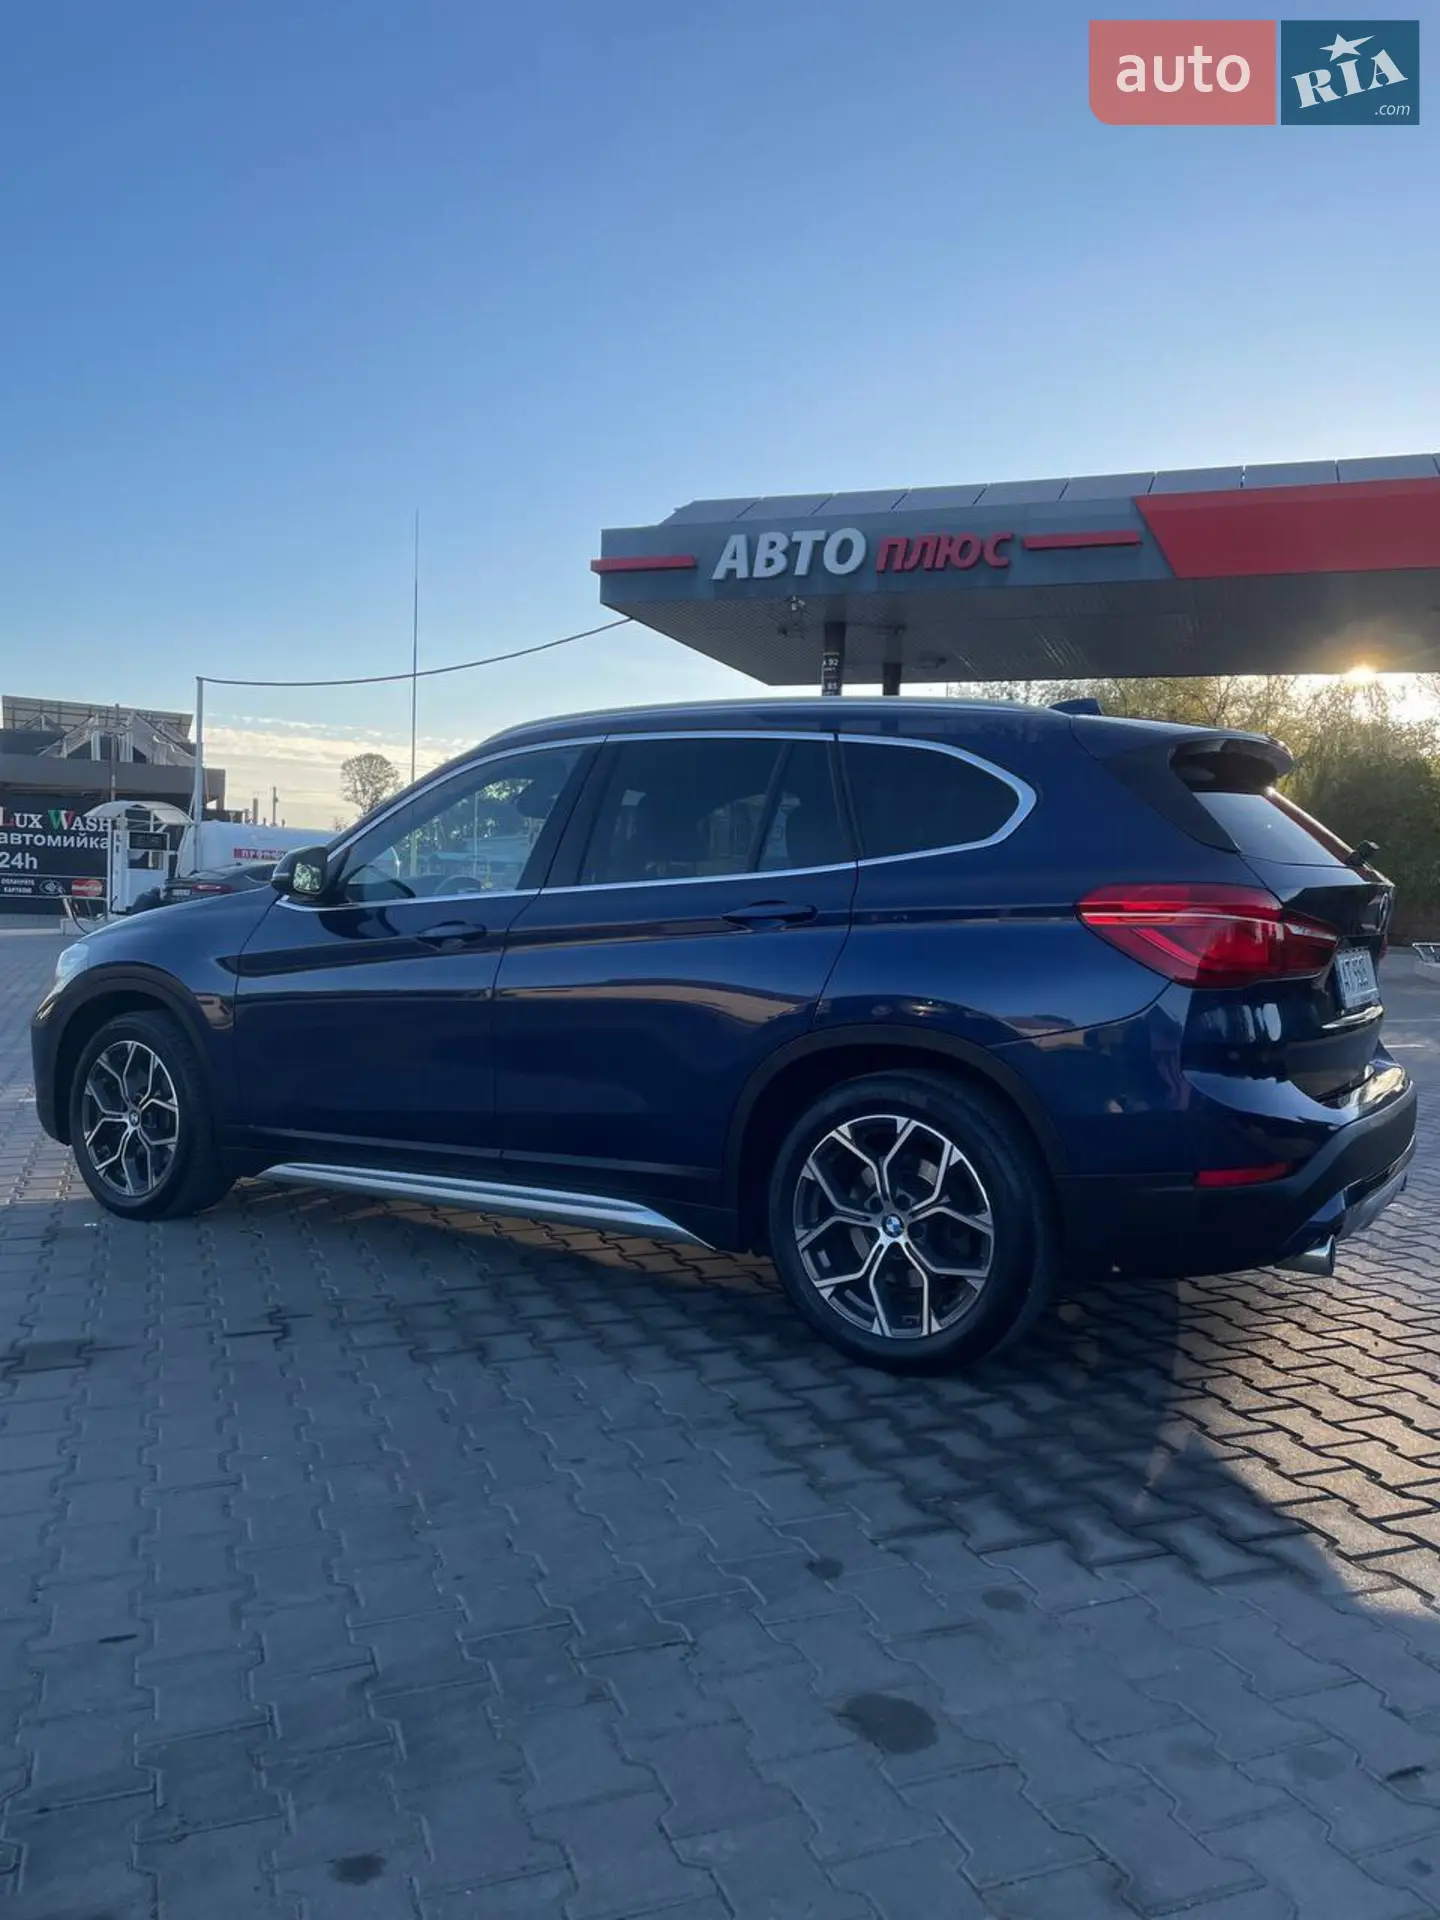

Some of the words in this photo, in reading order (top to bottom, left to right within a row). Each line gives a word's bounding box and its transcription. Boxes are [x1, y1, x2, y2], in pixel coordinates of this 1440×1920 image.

[711, 527, 867, 580] АВТО
[0, 831, 109, 849] автомийка
[0, 851, 38, 870] 24h
